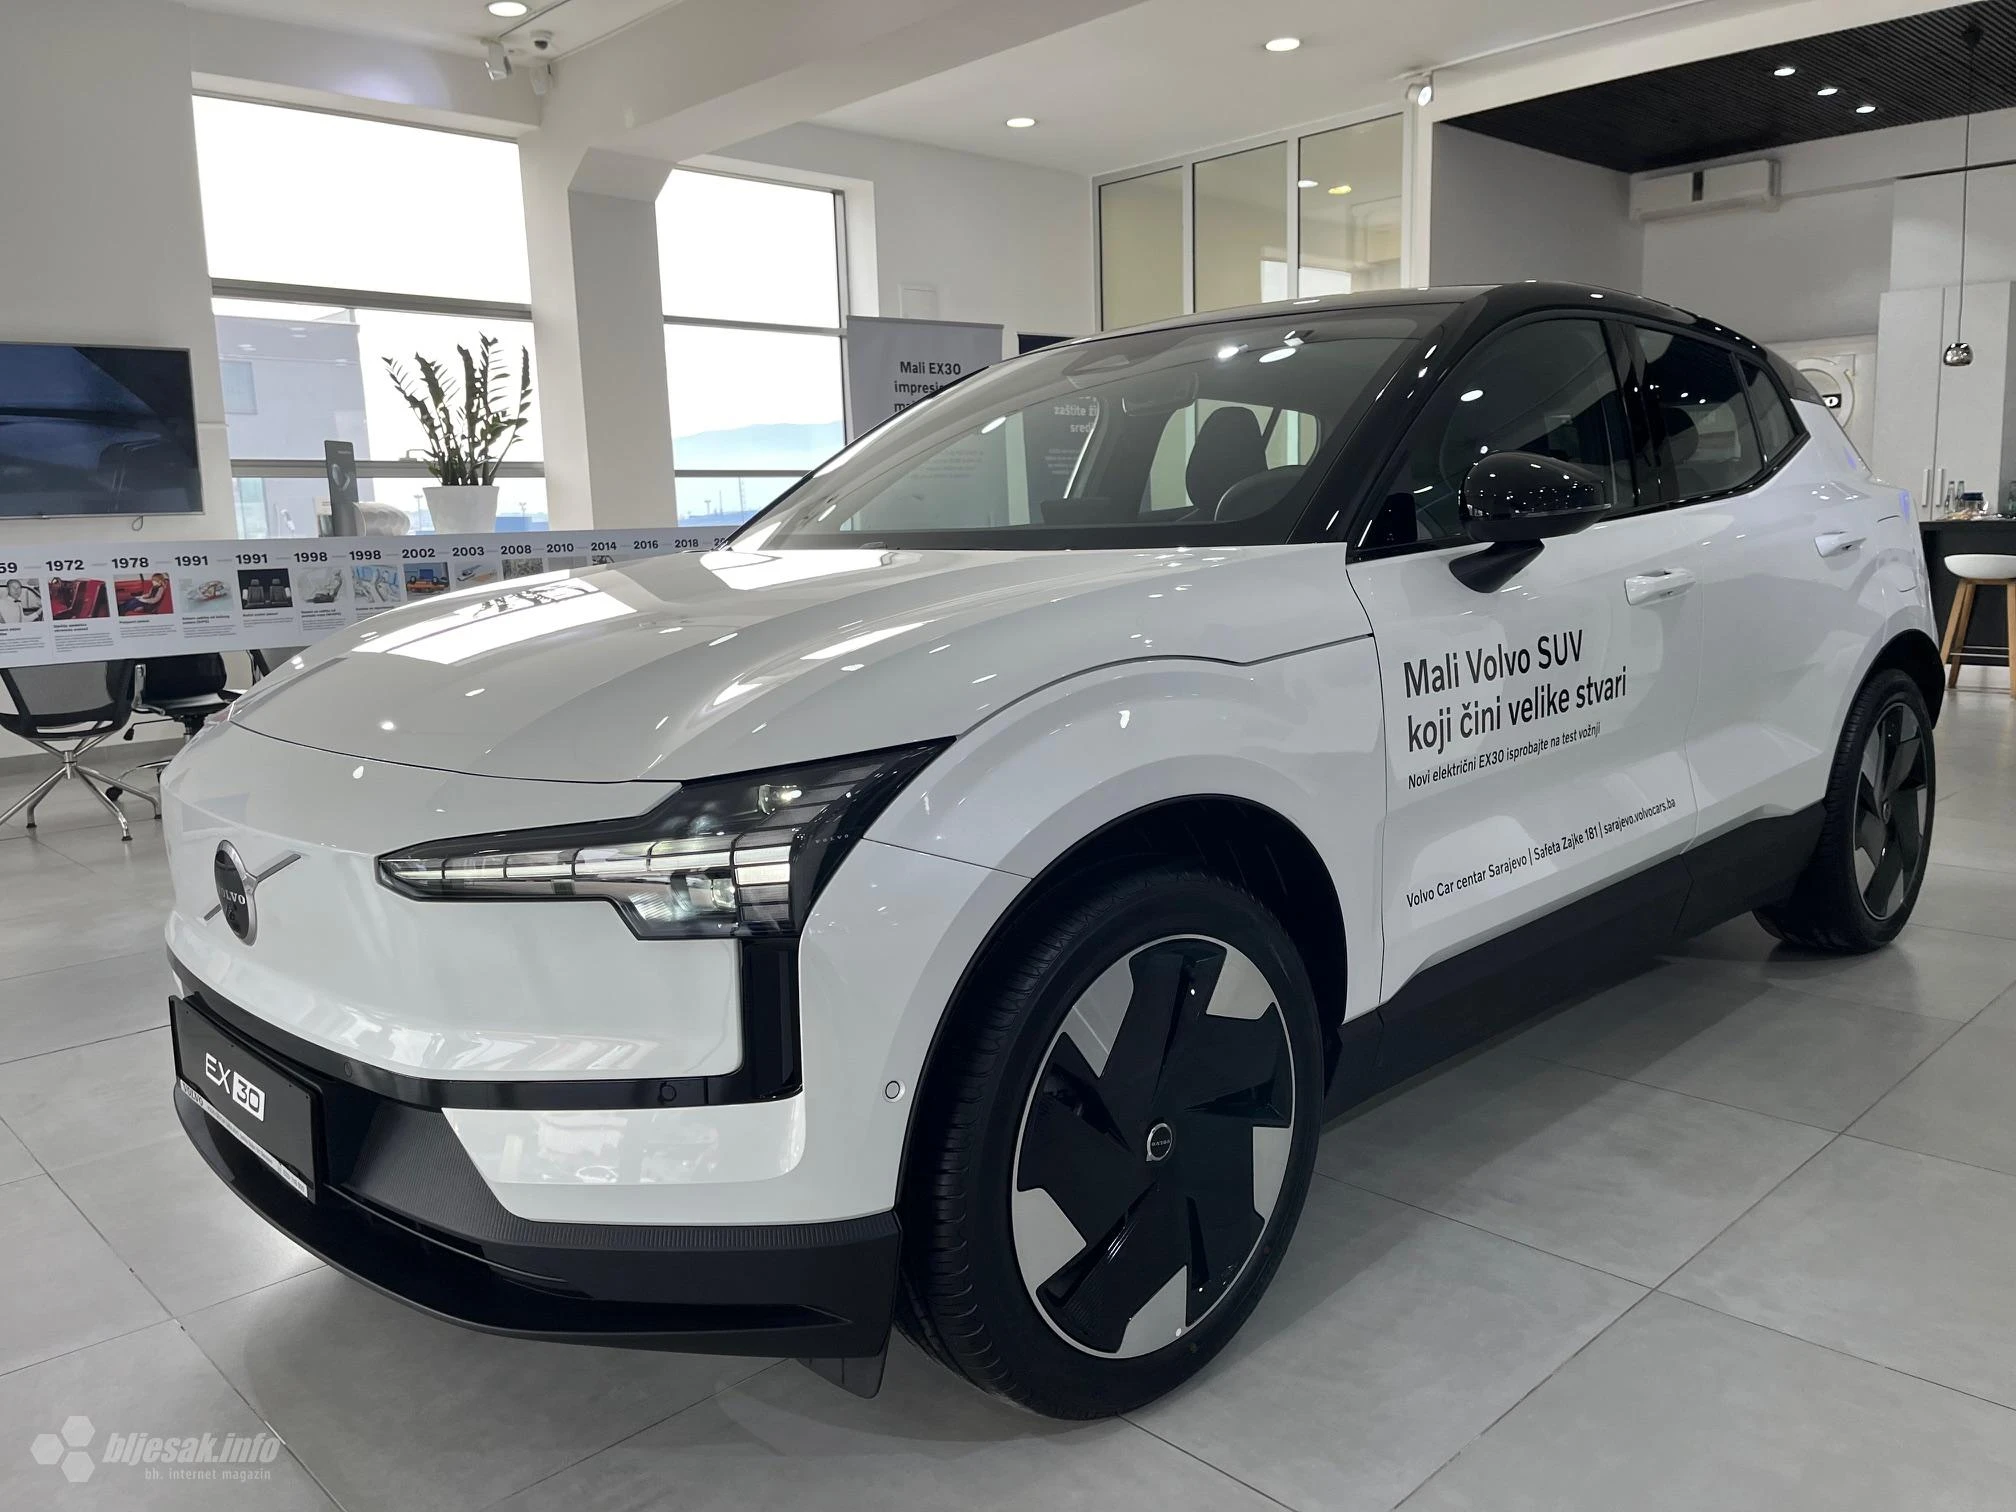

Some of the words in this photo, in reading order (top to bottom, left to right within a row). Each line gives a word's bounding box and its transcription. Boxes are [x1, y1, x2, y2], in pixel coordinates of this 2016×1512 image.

[900, 361, 925, 374] Mali
[929, 362, 961, 375] EX30
[46, 560, 85, 572] 1972
[112, 557, 149, 569] 1978
[175, 555, 209, 567] 1991
[235, 553, 269, 565] 1991
[294, 552, 328, 563] 1998
[349, 550, 382, 561] 1998
[402, 548, 436, 559] 2002
[452, 546, 485, 557] 2003
[500, 545, 532, 555] 2008
[547, 543, 574, 554] 2010
[591, 541, 617, 552] 2014
[633, 539, 659, 551] 2016
[675, 538, 699, 549] 2018
[1403, 652, 1459, 698] Mali
[1465, 643, 1530, 684] Volvo
[1537, 629, 1582, 669] SUV
[1408, 707, 1451, 754] koji
[1460, 695, 1500, 738] čini
[1508, 683, 1570, 726] velike
[1576, 665, 1626, 708] stvari
[1408, 769, 1431, 790] Novi
[1432, 757, 1476, 782] električni
[1479, 749, 1505, 768] EX30
[1506, 738, 1549, 761] isprobajte
[1550, 736, 1561, 748] na
[1562, 729, 1577, 745] test
[1578, 721, 1601, 740] vožnji
[1406, 889, 1435, 908] Volvo
[1436, 882, 1454, 896] Car
[1456, 869, 1486, 890] centar
[1488, 855, 1527, 878] Sarajevo
[1534, 842, 1560, 861] Safeta
[1561, 832, 1584, 850] Zajke
[1584, 825, 1598, 841] 181
[1604, 797, 1676, 834] sarajevo.volvocars.ba
